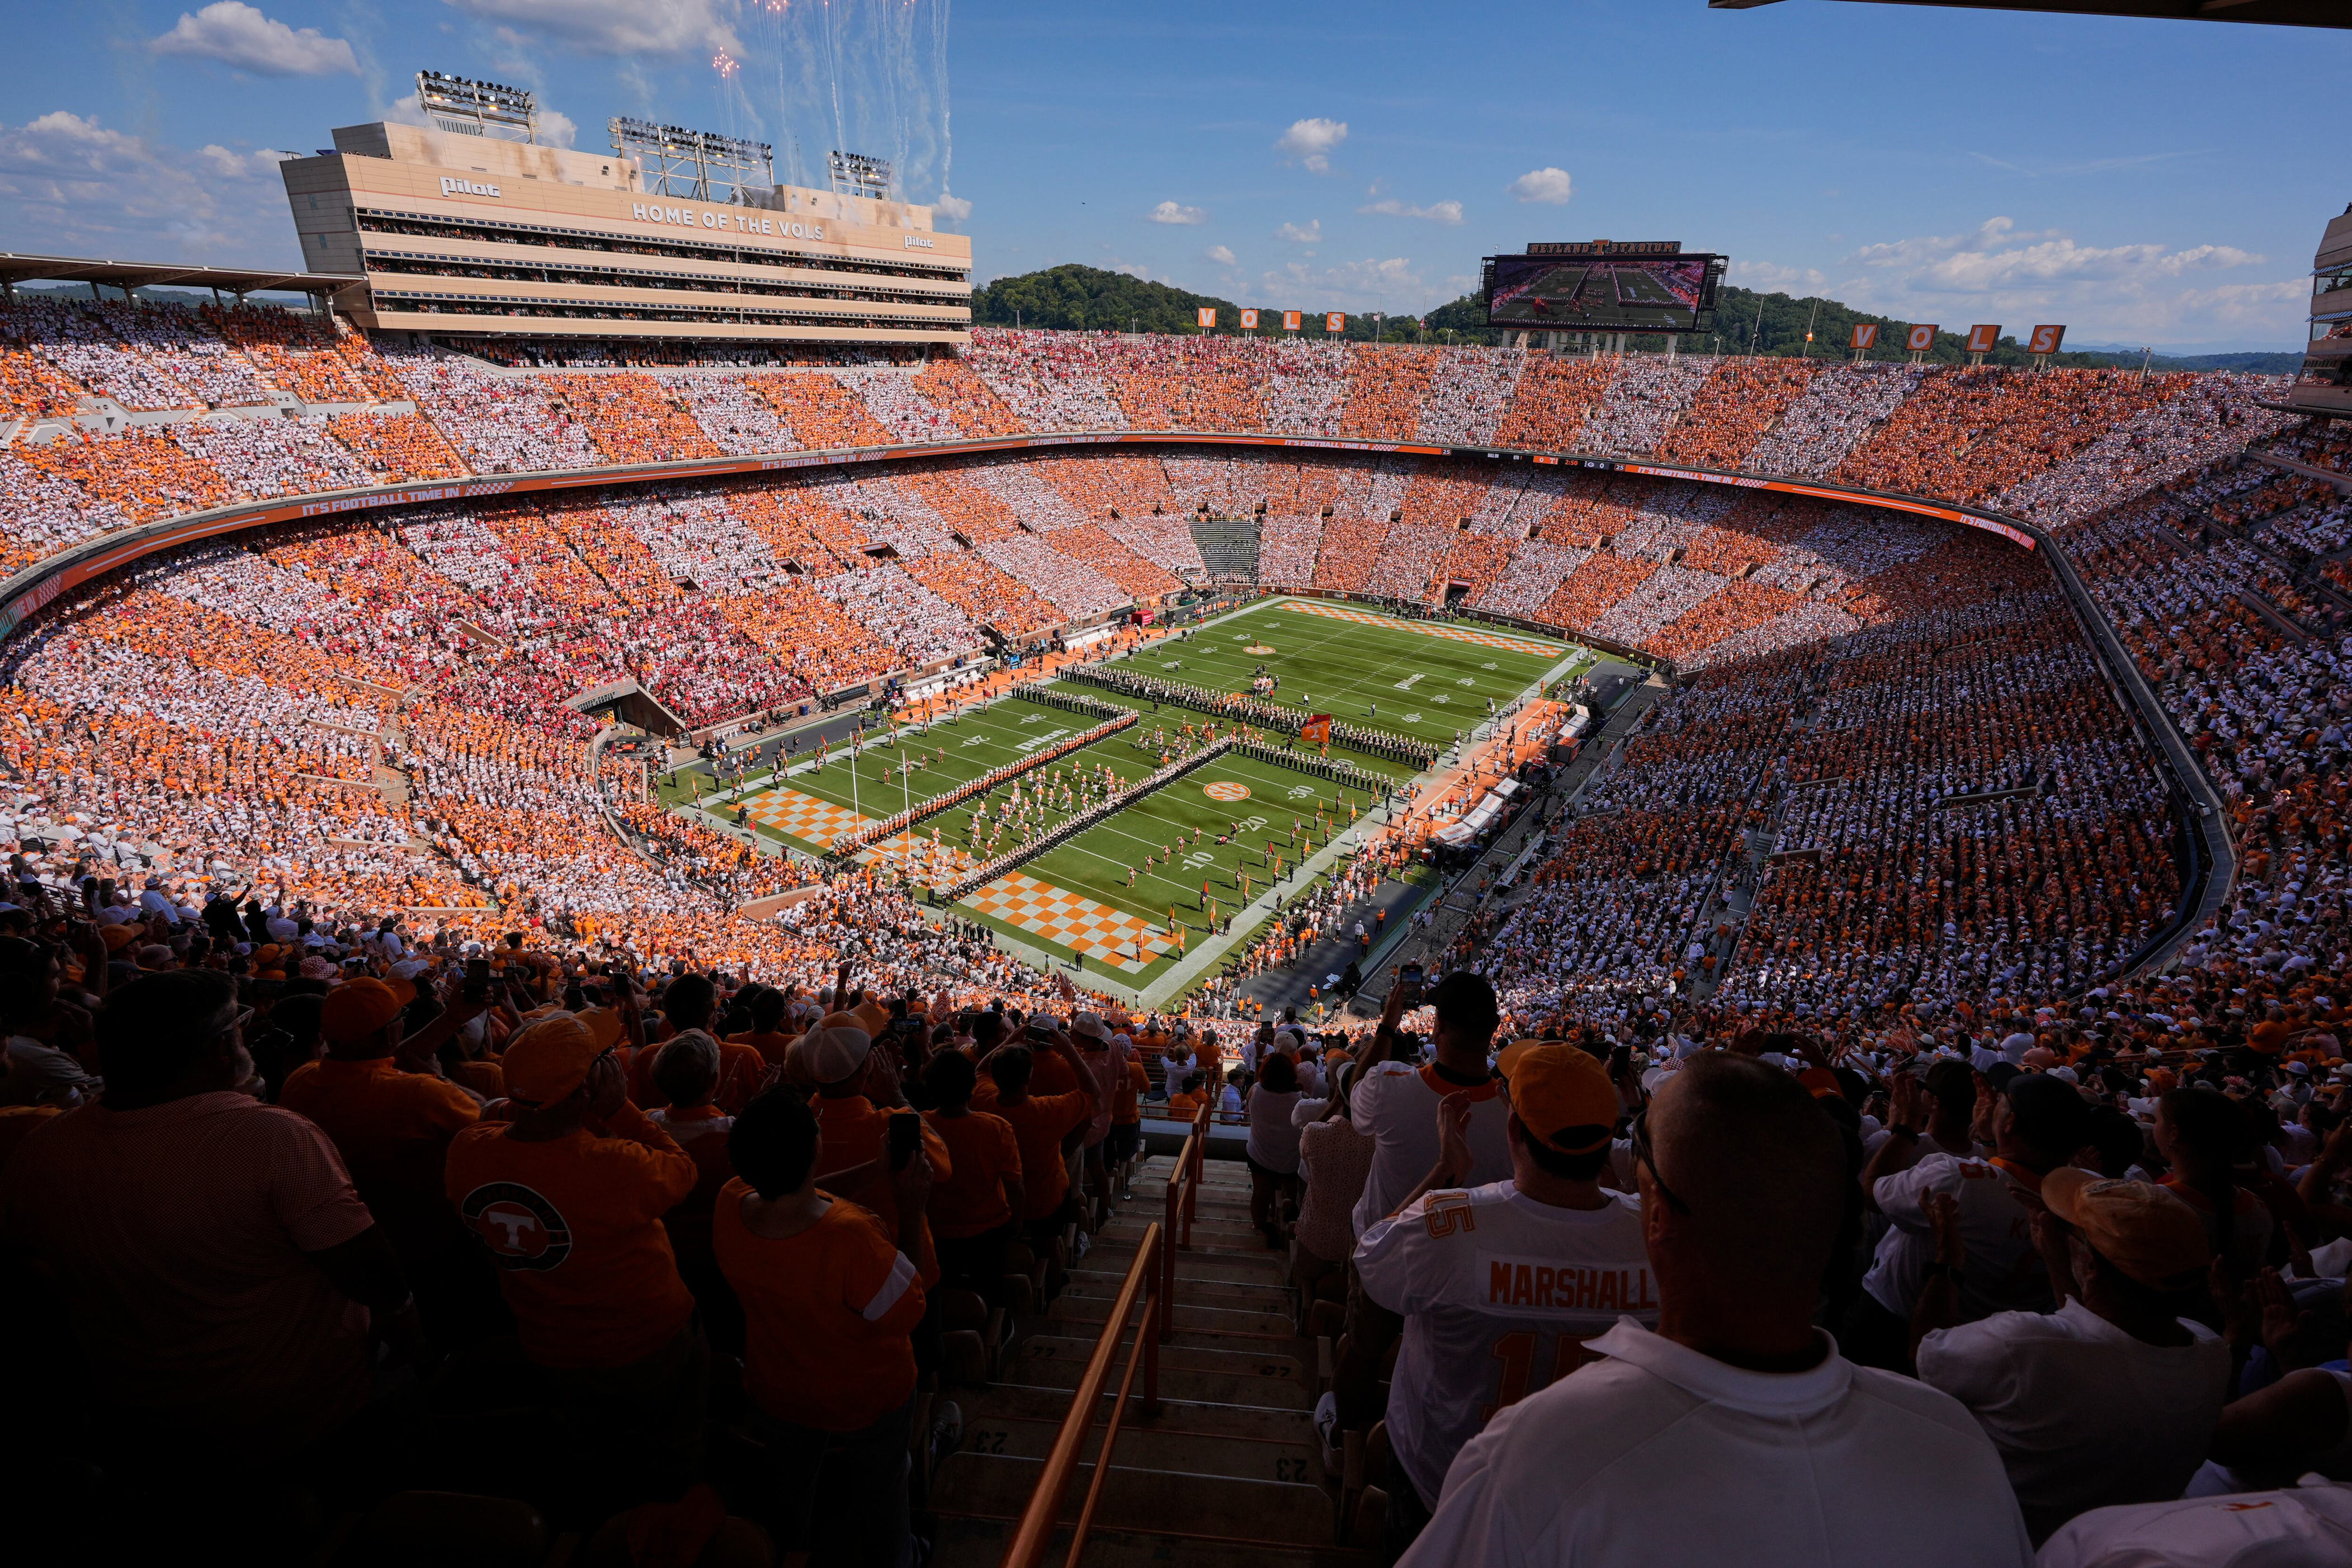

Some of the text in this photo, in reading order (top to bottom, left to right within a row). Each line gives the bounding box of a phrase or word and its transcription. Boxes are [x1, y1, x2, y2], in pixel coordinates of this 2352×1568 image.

[632, 203, 824, 240] HOME OF THE VOLS
[1531, 244, 1589, 253] NEYLAND
[1612, 243, 1674, 252] STADIUM
[762, 461, 780, 469] IT'S
[781, 457, 825, 467] FOOTBALL
[1655, 469, 1699, 480] FOOTBALL
[1701, 474, 1721, 482] TIME
[302, 488, 459, 516] IT'S FOOTBALL TIME IN
[1959, 514, 1975, 525] IT'S
[1975, 518, 2008, 535] FOOTBALL
[8, 601, 27, 626] TIME
[25, 594, 37, 612] IN
[848, 685, 867, 693] INSURANCE
[963, 735, 990, 745] 20
[1207, 783, 1245, 801] SEC
[1288, 785, 1314, 799] 30
[1239, 816, 1268, 832] 20
[1182, 852, 1214, 869] 10
[1424, 1192, 1475, 1240] 15
[1489, 1261, 1657, 1310] MARSHALL
